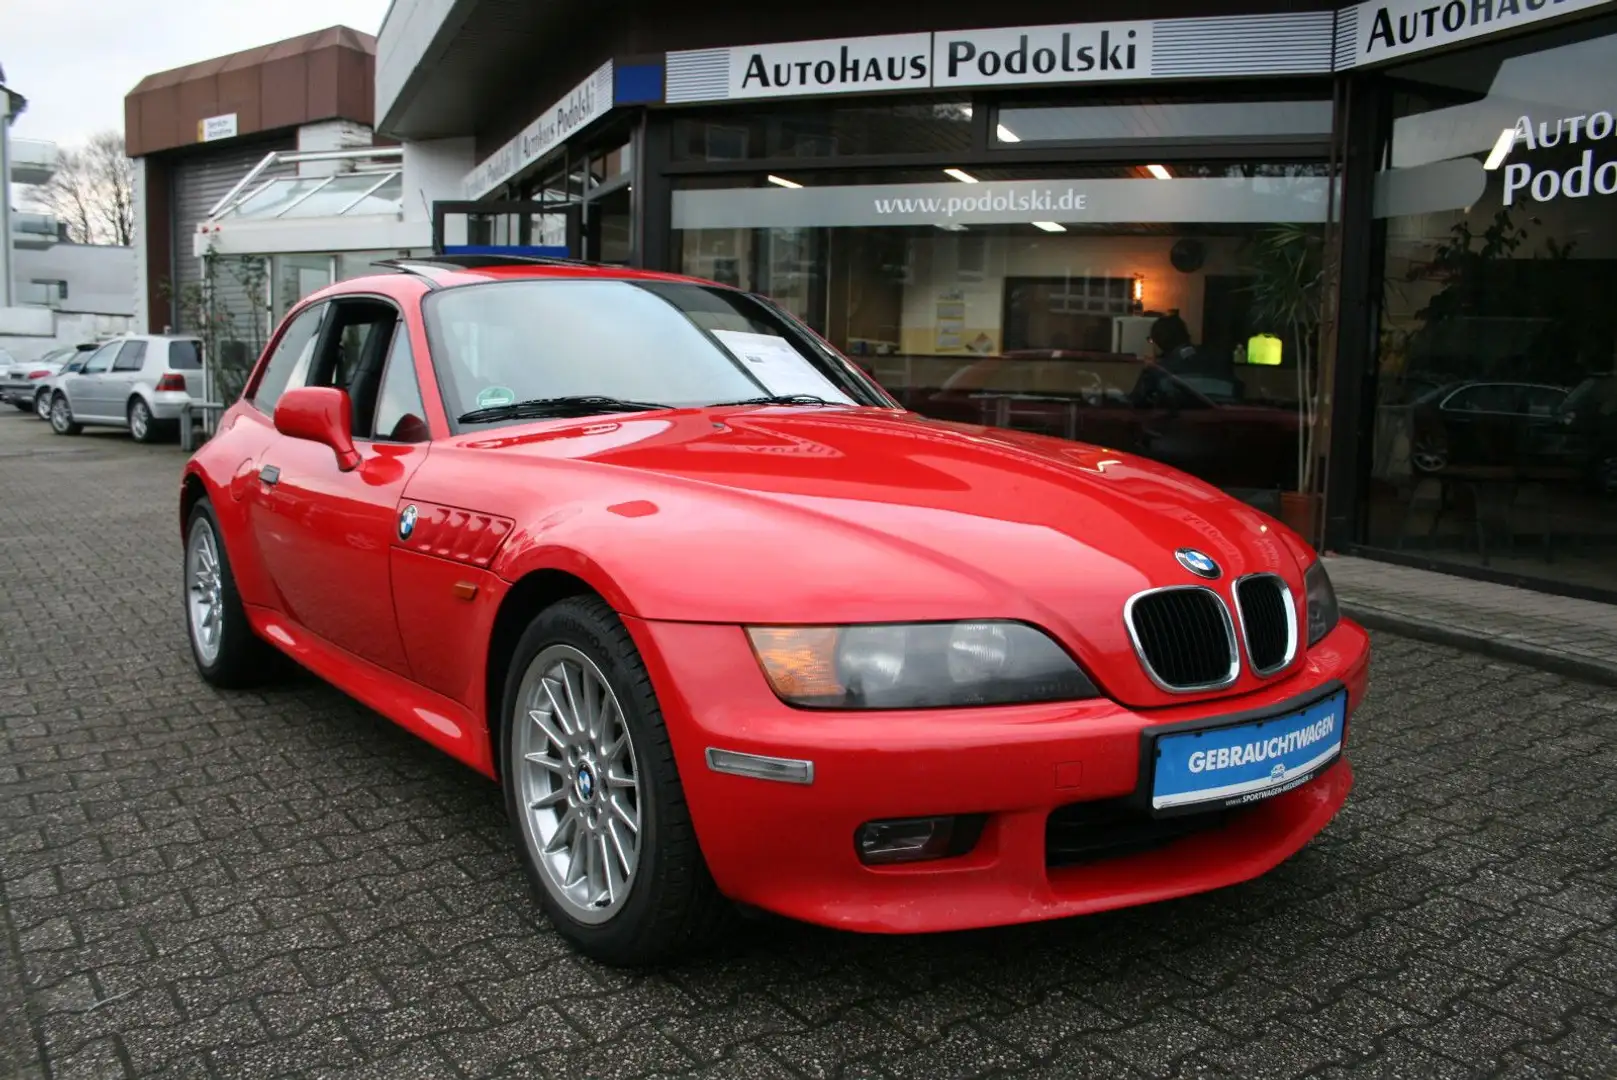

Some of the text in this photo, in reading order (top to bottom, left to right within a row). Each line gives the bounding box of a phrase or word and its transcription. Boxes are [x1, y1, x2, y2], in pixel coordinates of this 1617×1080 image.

[947, 29, 1136, 78] Podolski
[874, 188, 1088, 217] www.podolski.de
[1188, 713, 1335, 774] GEBRAUCHTWAGEN
